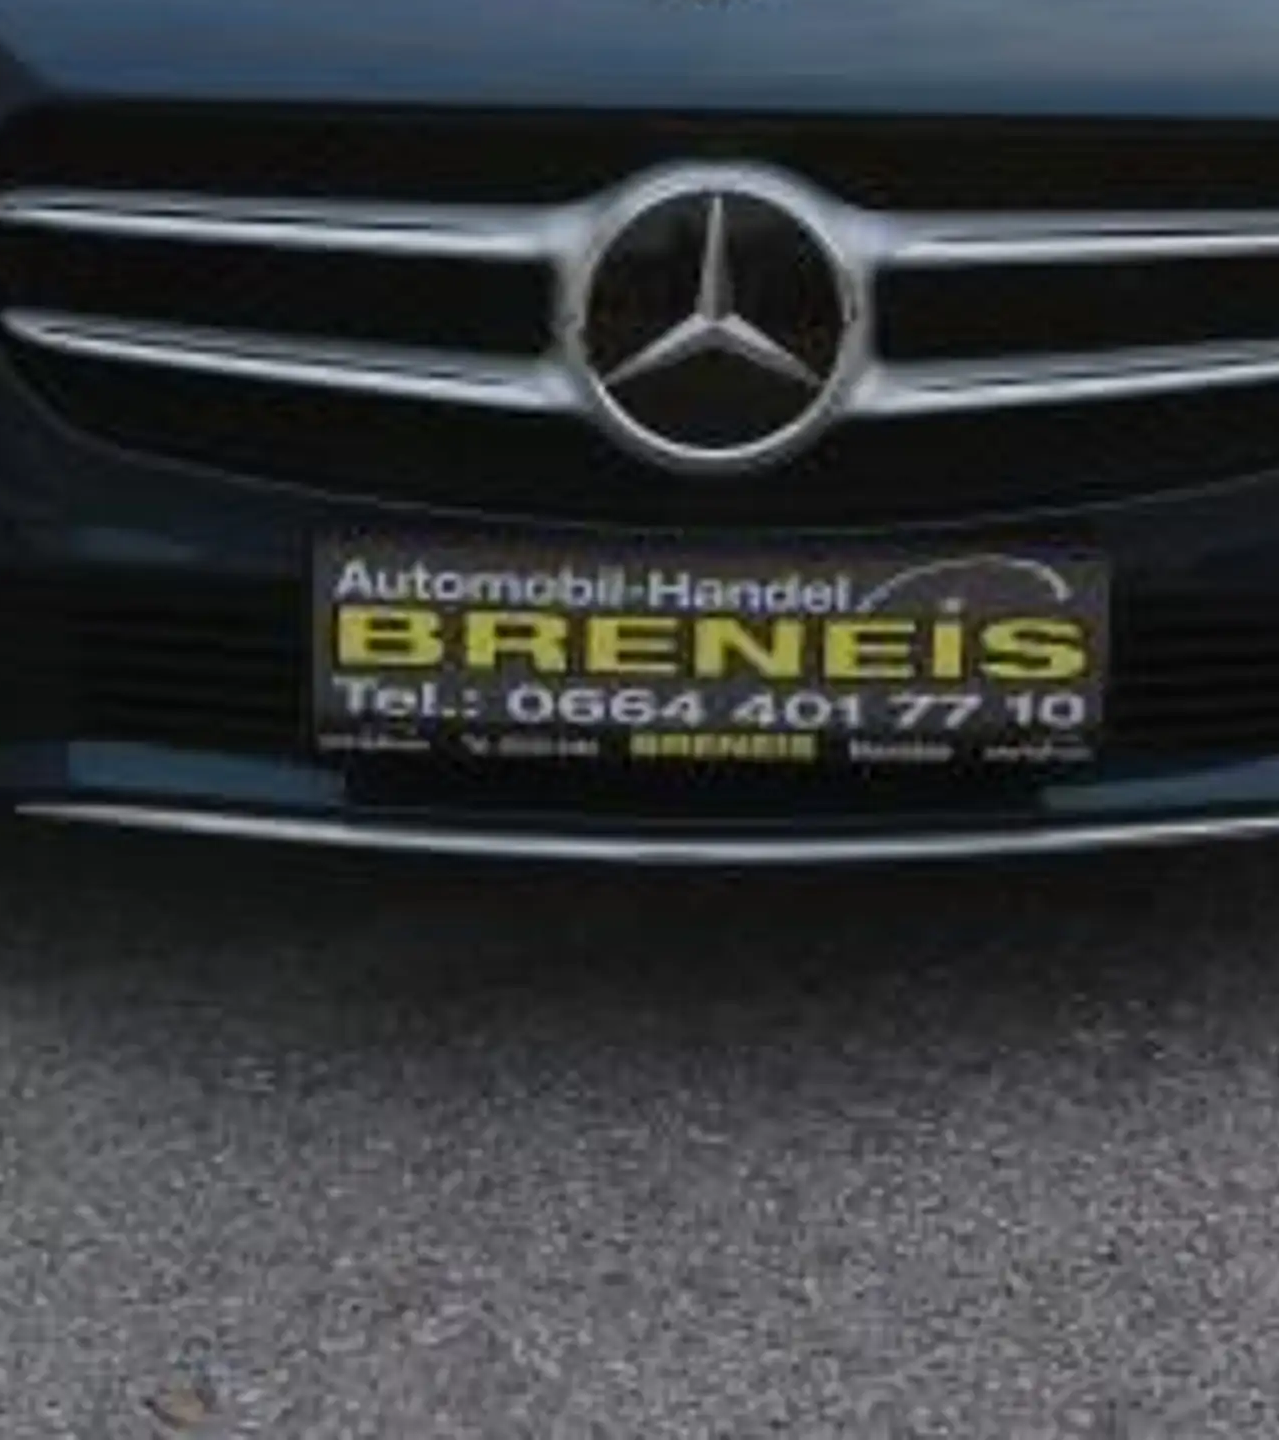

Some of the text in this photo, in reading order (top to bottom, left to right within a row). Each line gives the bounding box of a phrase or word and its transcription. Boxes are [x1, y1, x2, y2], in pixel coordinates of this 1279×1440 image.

[336, 559, 851, 613] Automobil-Handel
[332, 676, 1086, 730] Tel.: 0664 401 77 10
